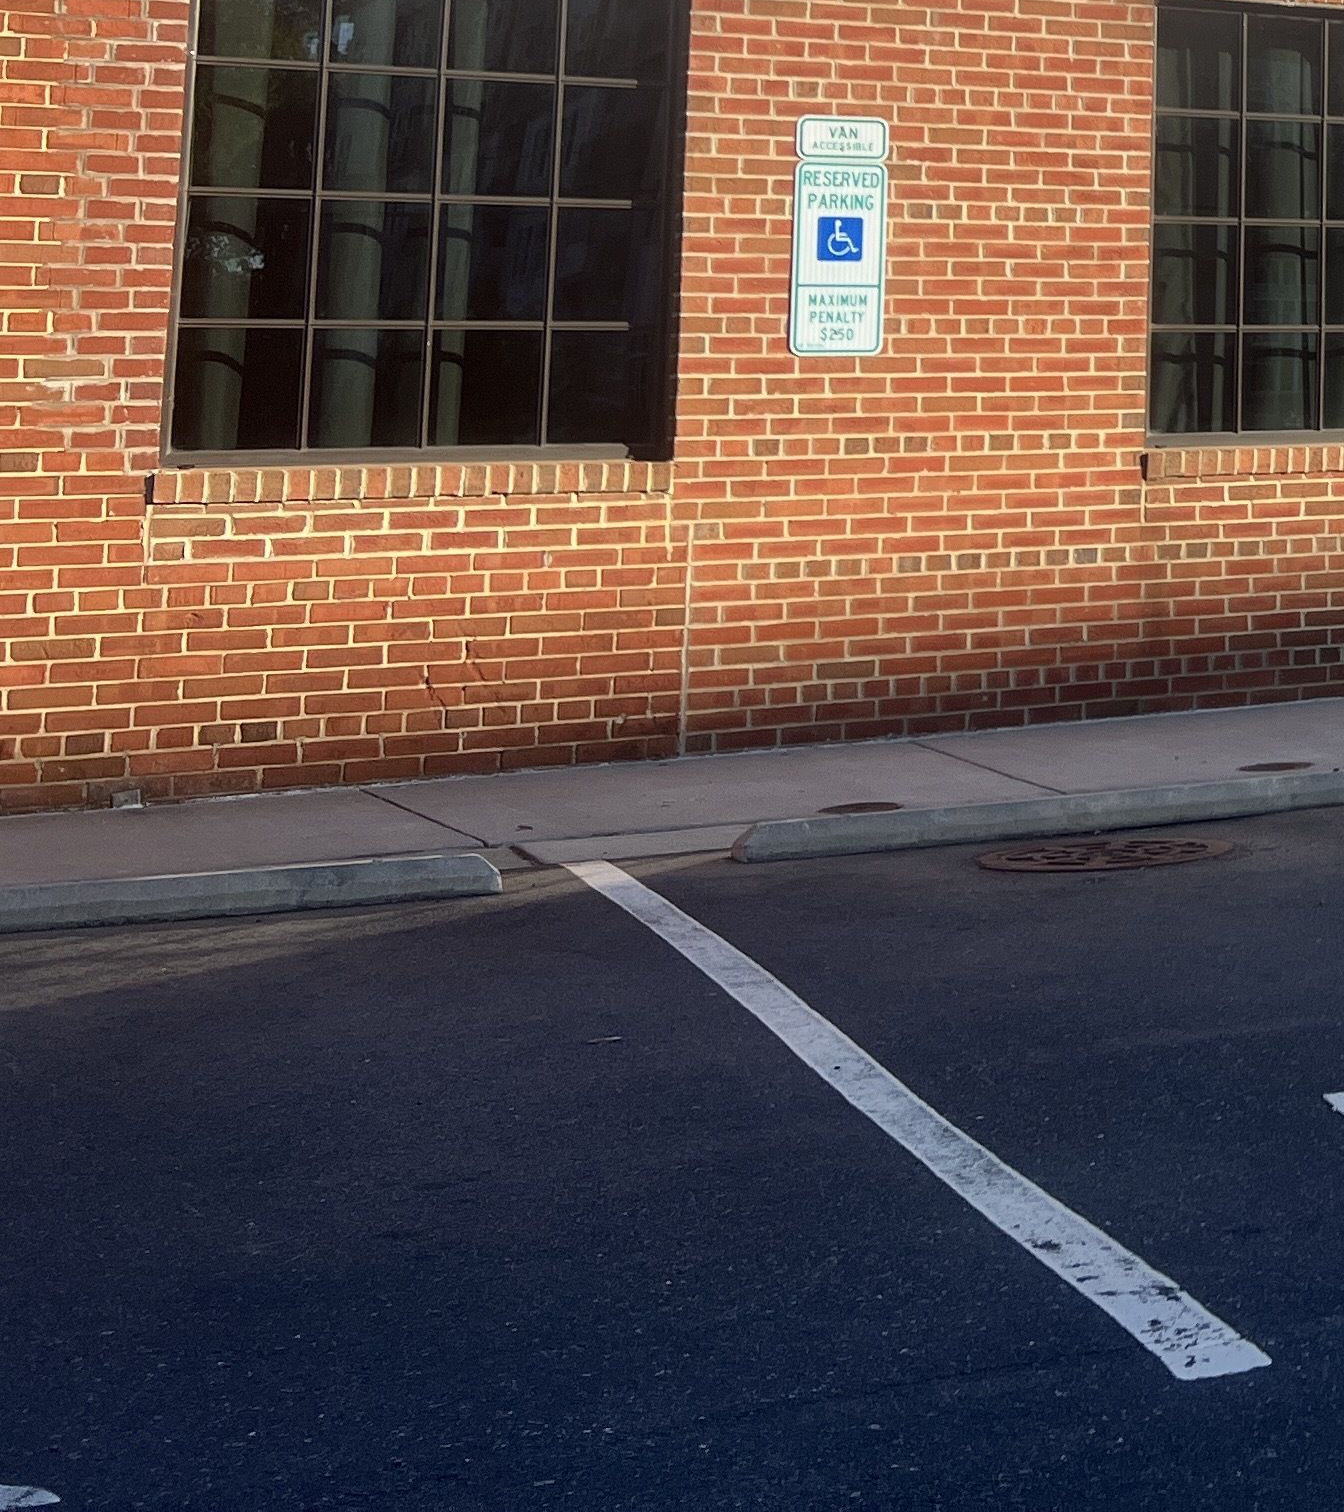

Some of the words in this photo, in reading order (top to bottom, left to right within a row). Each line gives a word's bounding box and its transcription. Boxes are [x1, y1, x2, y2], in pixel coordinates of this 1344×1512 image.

[829, 126, 858, 139] VAN
[812, 140, 873, 152] ACCESSIBLE
[803, 170, 880, 188] RESERVED
[807, 193, 875, 211] PARKING
[808, 294, 867, 306] MAXIMUM
[809, 311, 864, 323] PENALTY
[820, 327, 854, 341] $250
